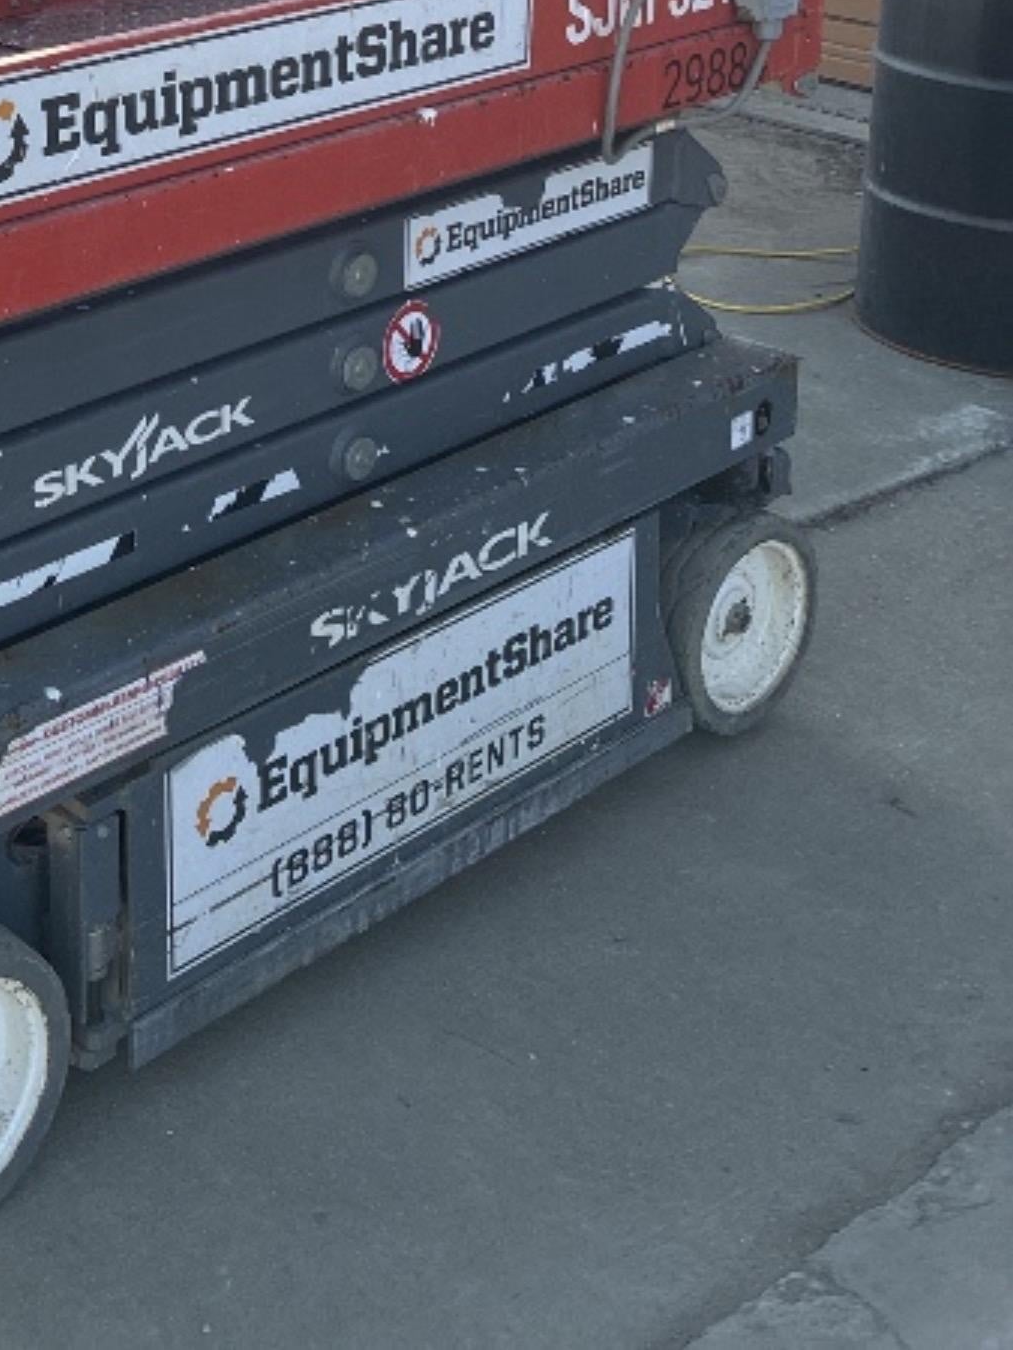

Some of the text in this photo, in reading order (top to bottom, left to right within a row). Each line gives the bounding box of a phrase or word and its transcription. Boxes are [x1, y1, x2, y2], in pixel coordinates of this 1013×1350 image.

[41, 10, 496, 156] EquipmentShare
[446, 170, 645, 252] EquipmentShare
[34, 395, 256, 509] SKYJACK
[257, 595, 613, 815] EquipmentShare
[271, 714, 547, 898] (888) 80-RENTS
